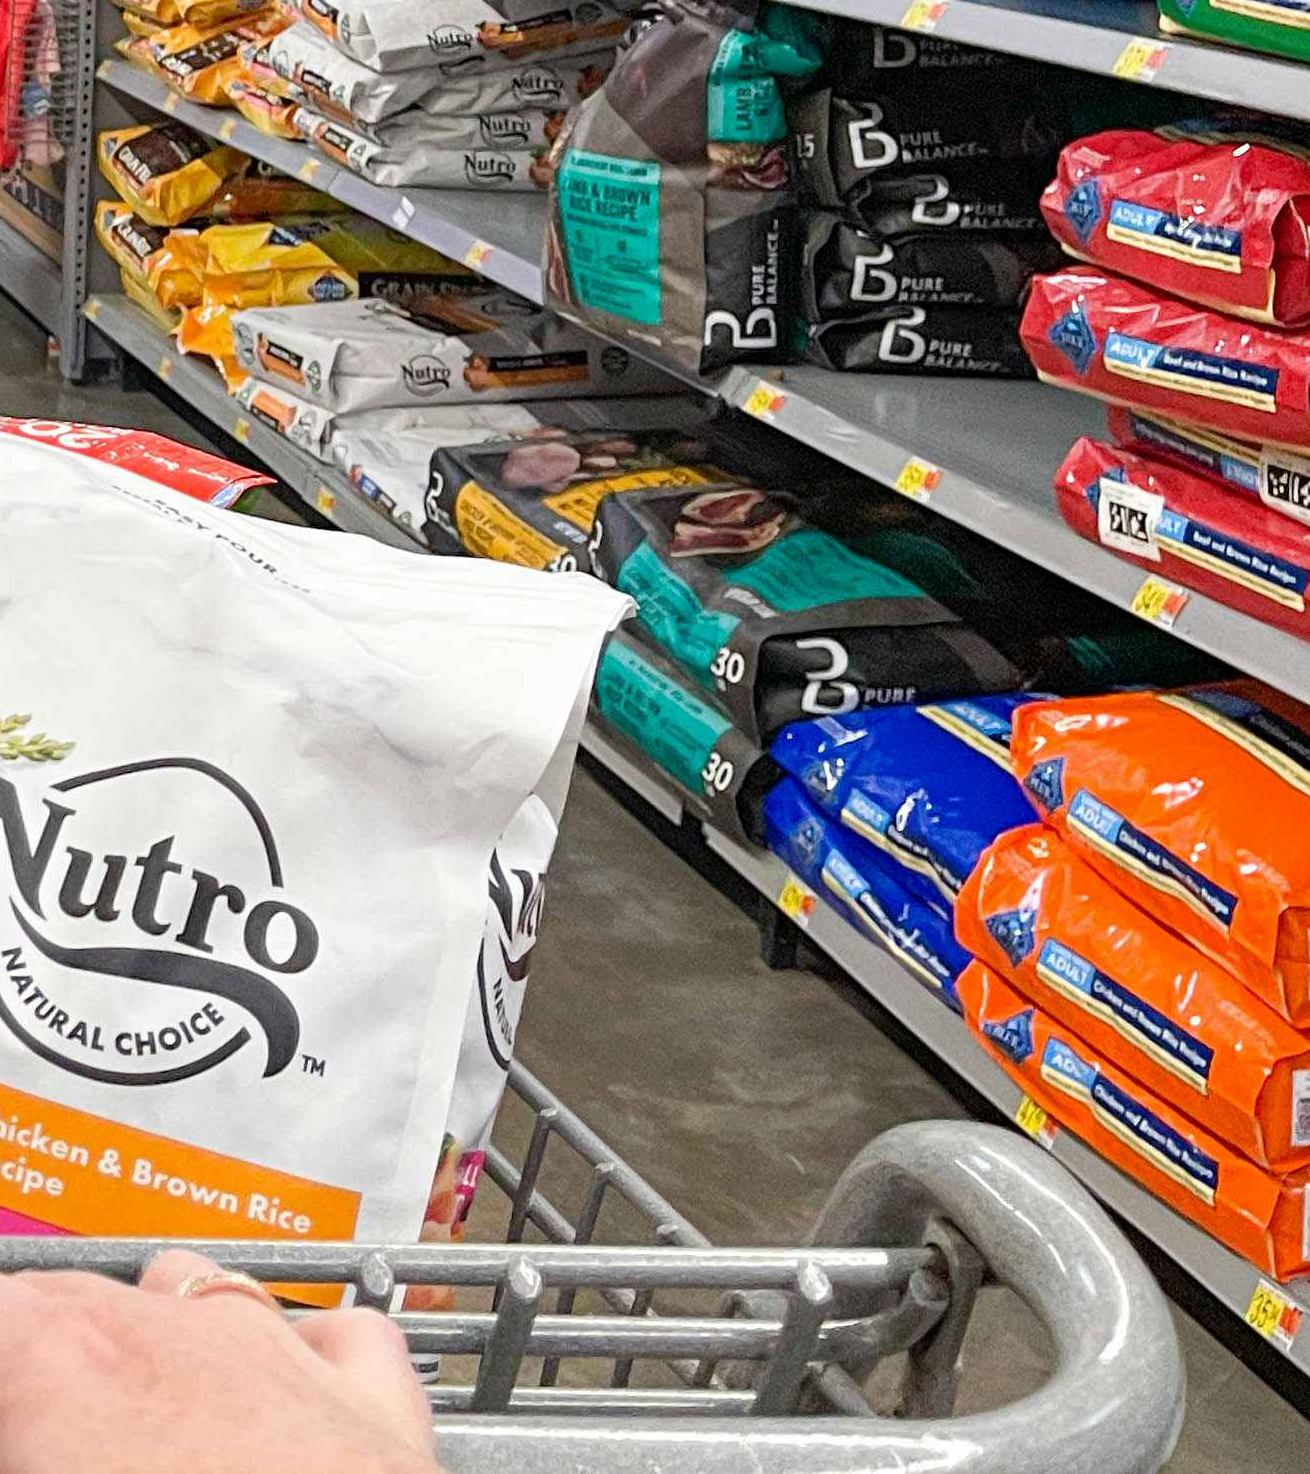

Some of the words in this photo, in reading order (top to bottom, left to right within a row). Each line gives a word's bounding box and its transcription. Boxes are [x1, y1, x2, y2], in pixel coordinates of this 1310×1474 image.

[427, 29, 473, 52] Nutro
[480, 113, 531, 136] Nutro
[901, 130, 943, 145] PURE
[463, 154, 516, 177] Nutro
[901, 142, 980, 162] BALANCE
[603, 183, 651, 206] BROWN
[964, 204, 1008, 217] PURE
[765, 231, 780, 305] BALANCE
[751, 264, 767, 305] PURE
[898, 278, 944, 293] PURE
[928, 341, 973, 357] PURE
[401, 358, 452, 389] Nutro
[214, 531, 278, 576] POUR
[1192, 529, 1211, 546] Beef
[1269, 560, 1298, 585] Recipe
[711, 647, 745, 687] 30
[864, 687, 917, 705] PURE
[703, 751, 734, 790] 30
[1046, 950, 1090, 985] ADULT
[0, 946, 108, 1054] NATURAL
[112, 1001, 229, 1059] CHOICE
[299, 1054, 327, 1079] TM
[1093, 1083, 1125, 1114] Chicken
[1182, 1148, 1215, 1182] Recipe
[96, 1144, 123, 1178] &
[131, 1157, 243, 1213] Brown
[245, 1183, 313, 1235] Rice
